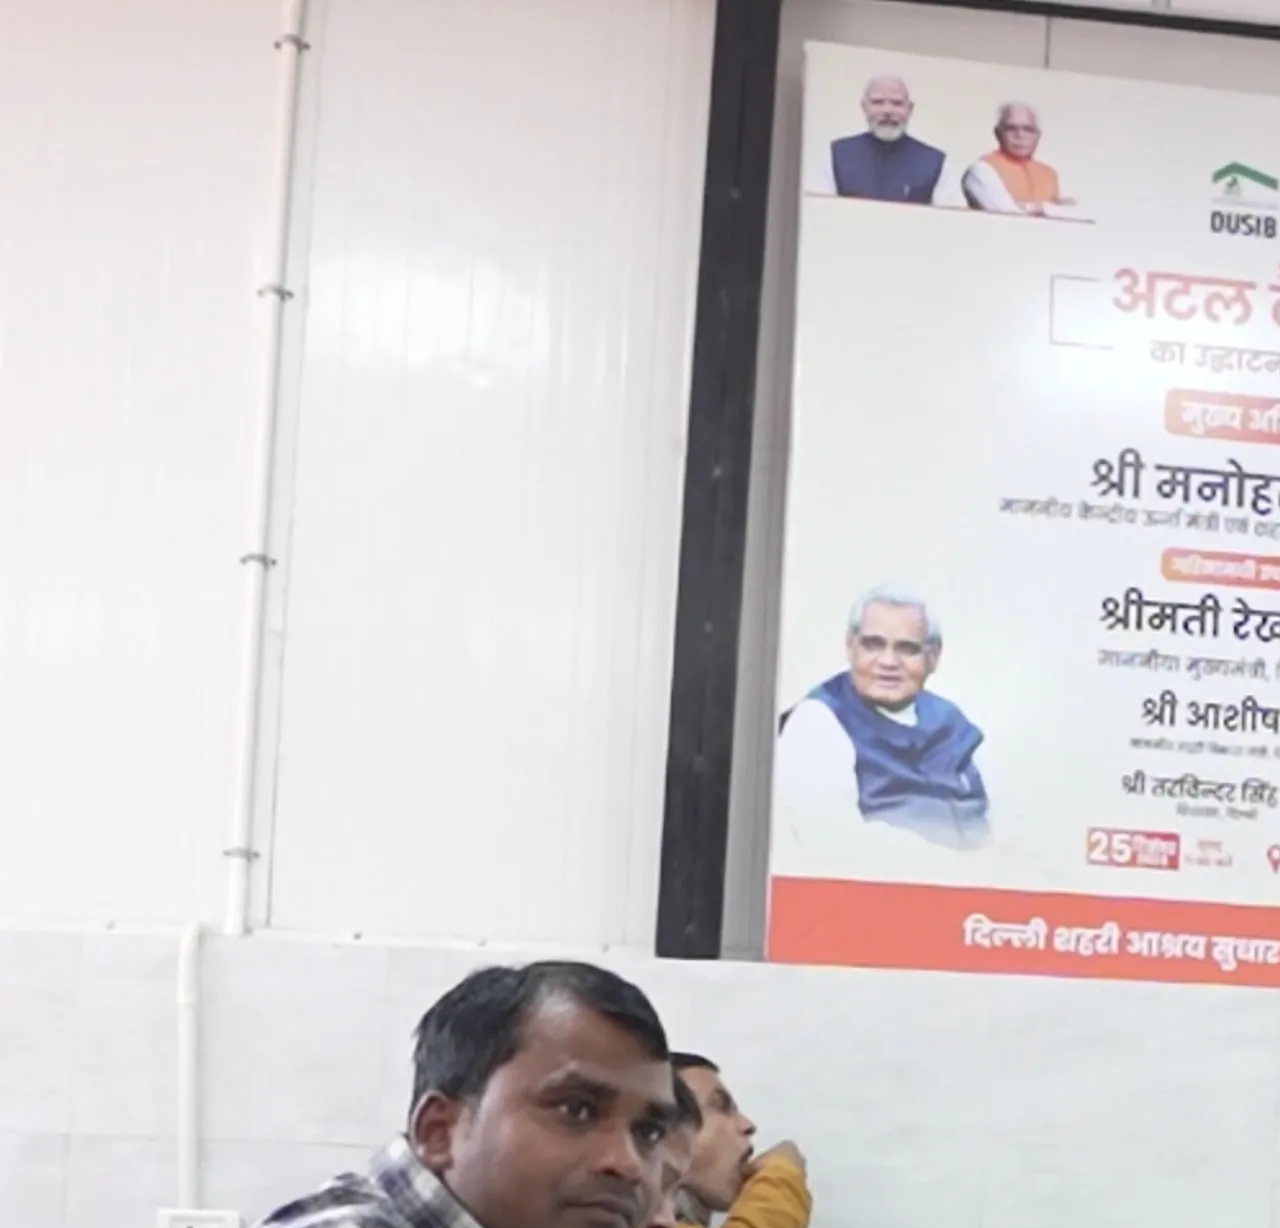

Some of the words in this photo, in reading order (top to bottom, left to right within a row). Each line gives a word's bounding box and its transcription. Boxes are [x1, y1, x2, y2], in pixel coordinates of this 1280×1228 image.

[1210, 210, 1278, 239] DUSIB
[1112, 267, 1257, 328] अटल
[1149, 339, 1186, 367] का
[1090, 447, 1146, 499] श्री
[1100, 586, 1223, 638] श्रीमती
[1141, 689, 1180, 728] श्री
[1089, 829, 1133, 864] 25
[963, 912, 1048, 950] दिल्ली
[1053, 920, 1121, 956] शहरी
[1126, 930, 1206, 960] आश्रय
